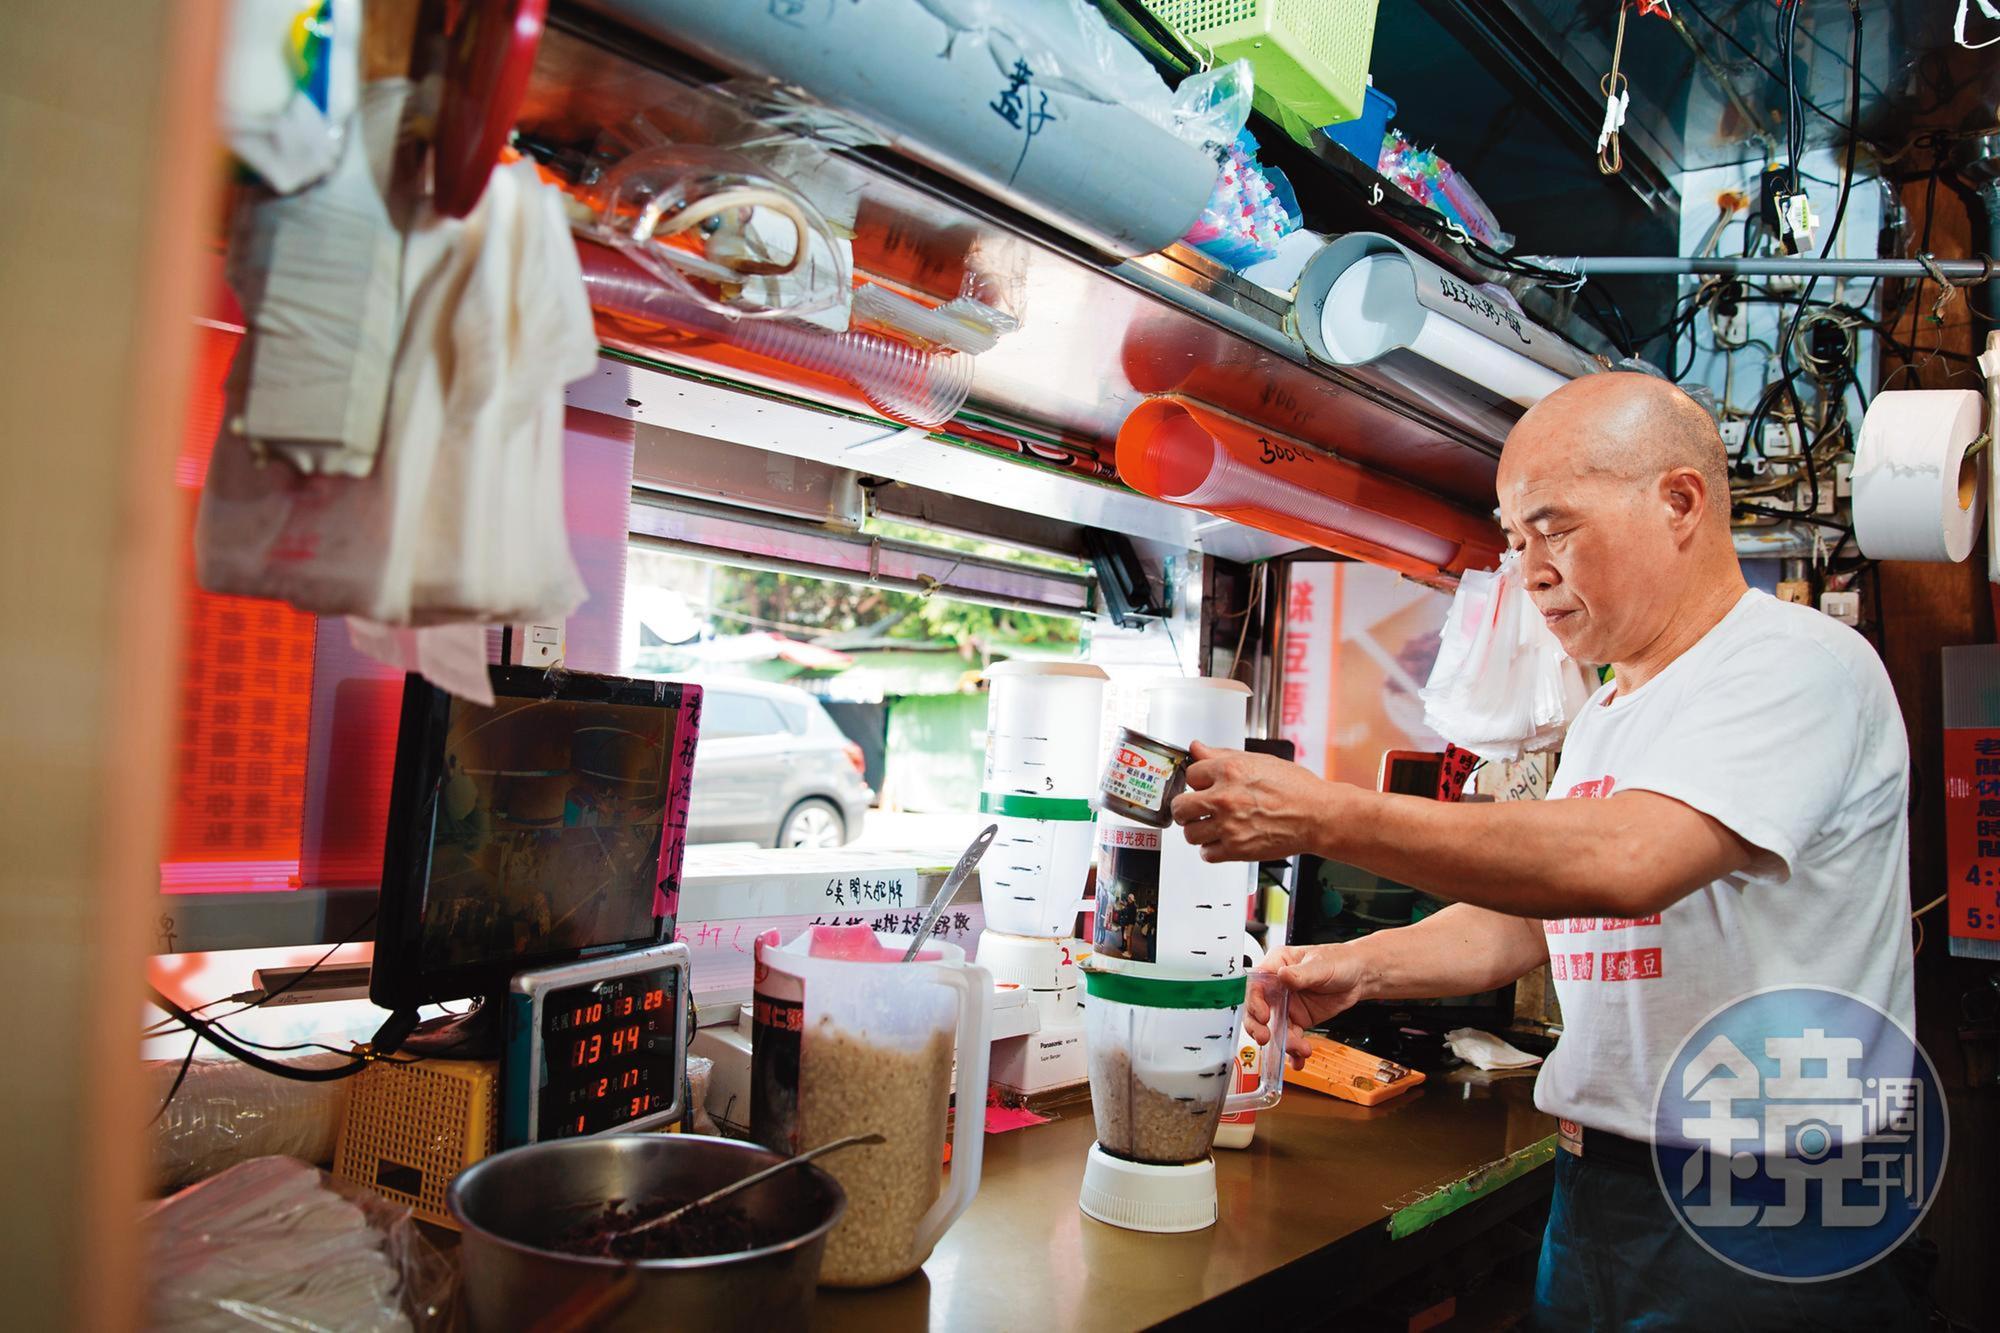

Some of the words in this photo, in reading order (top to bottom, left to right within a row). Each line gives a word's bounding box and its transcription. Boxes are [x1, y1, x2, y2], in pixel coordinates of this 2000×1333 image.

[1965, 864, 2000, 887] 4:
[1967, 907, 2000, 930] 5:
[623, 996, 633, 1016] 3
[643, 989, 664, 1011] 29
